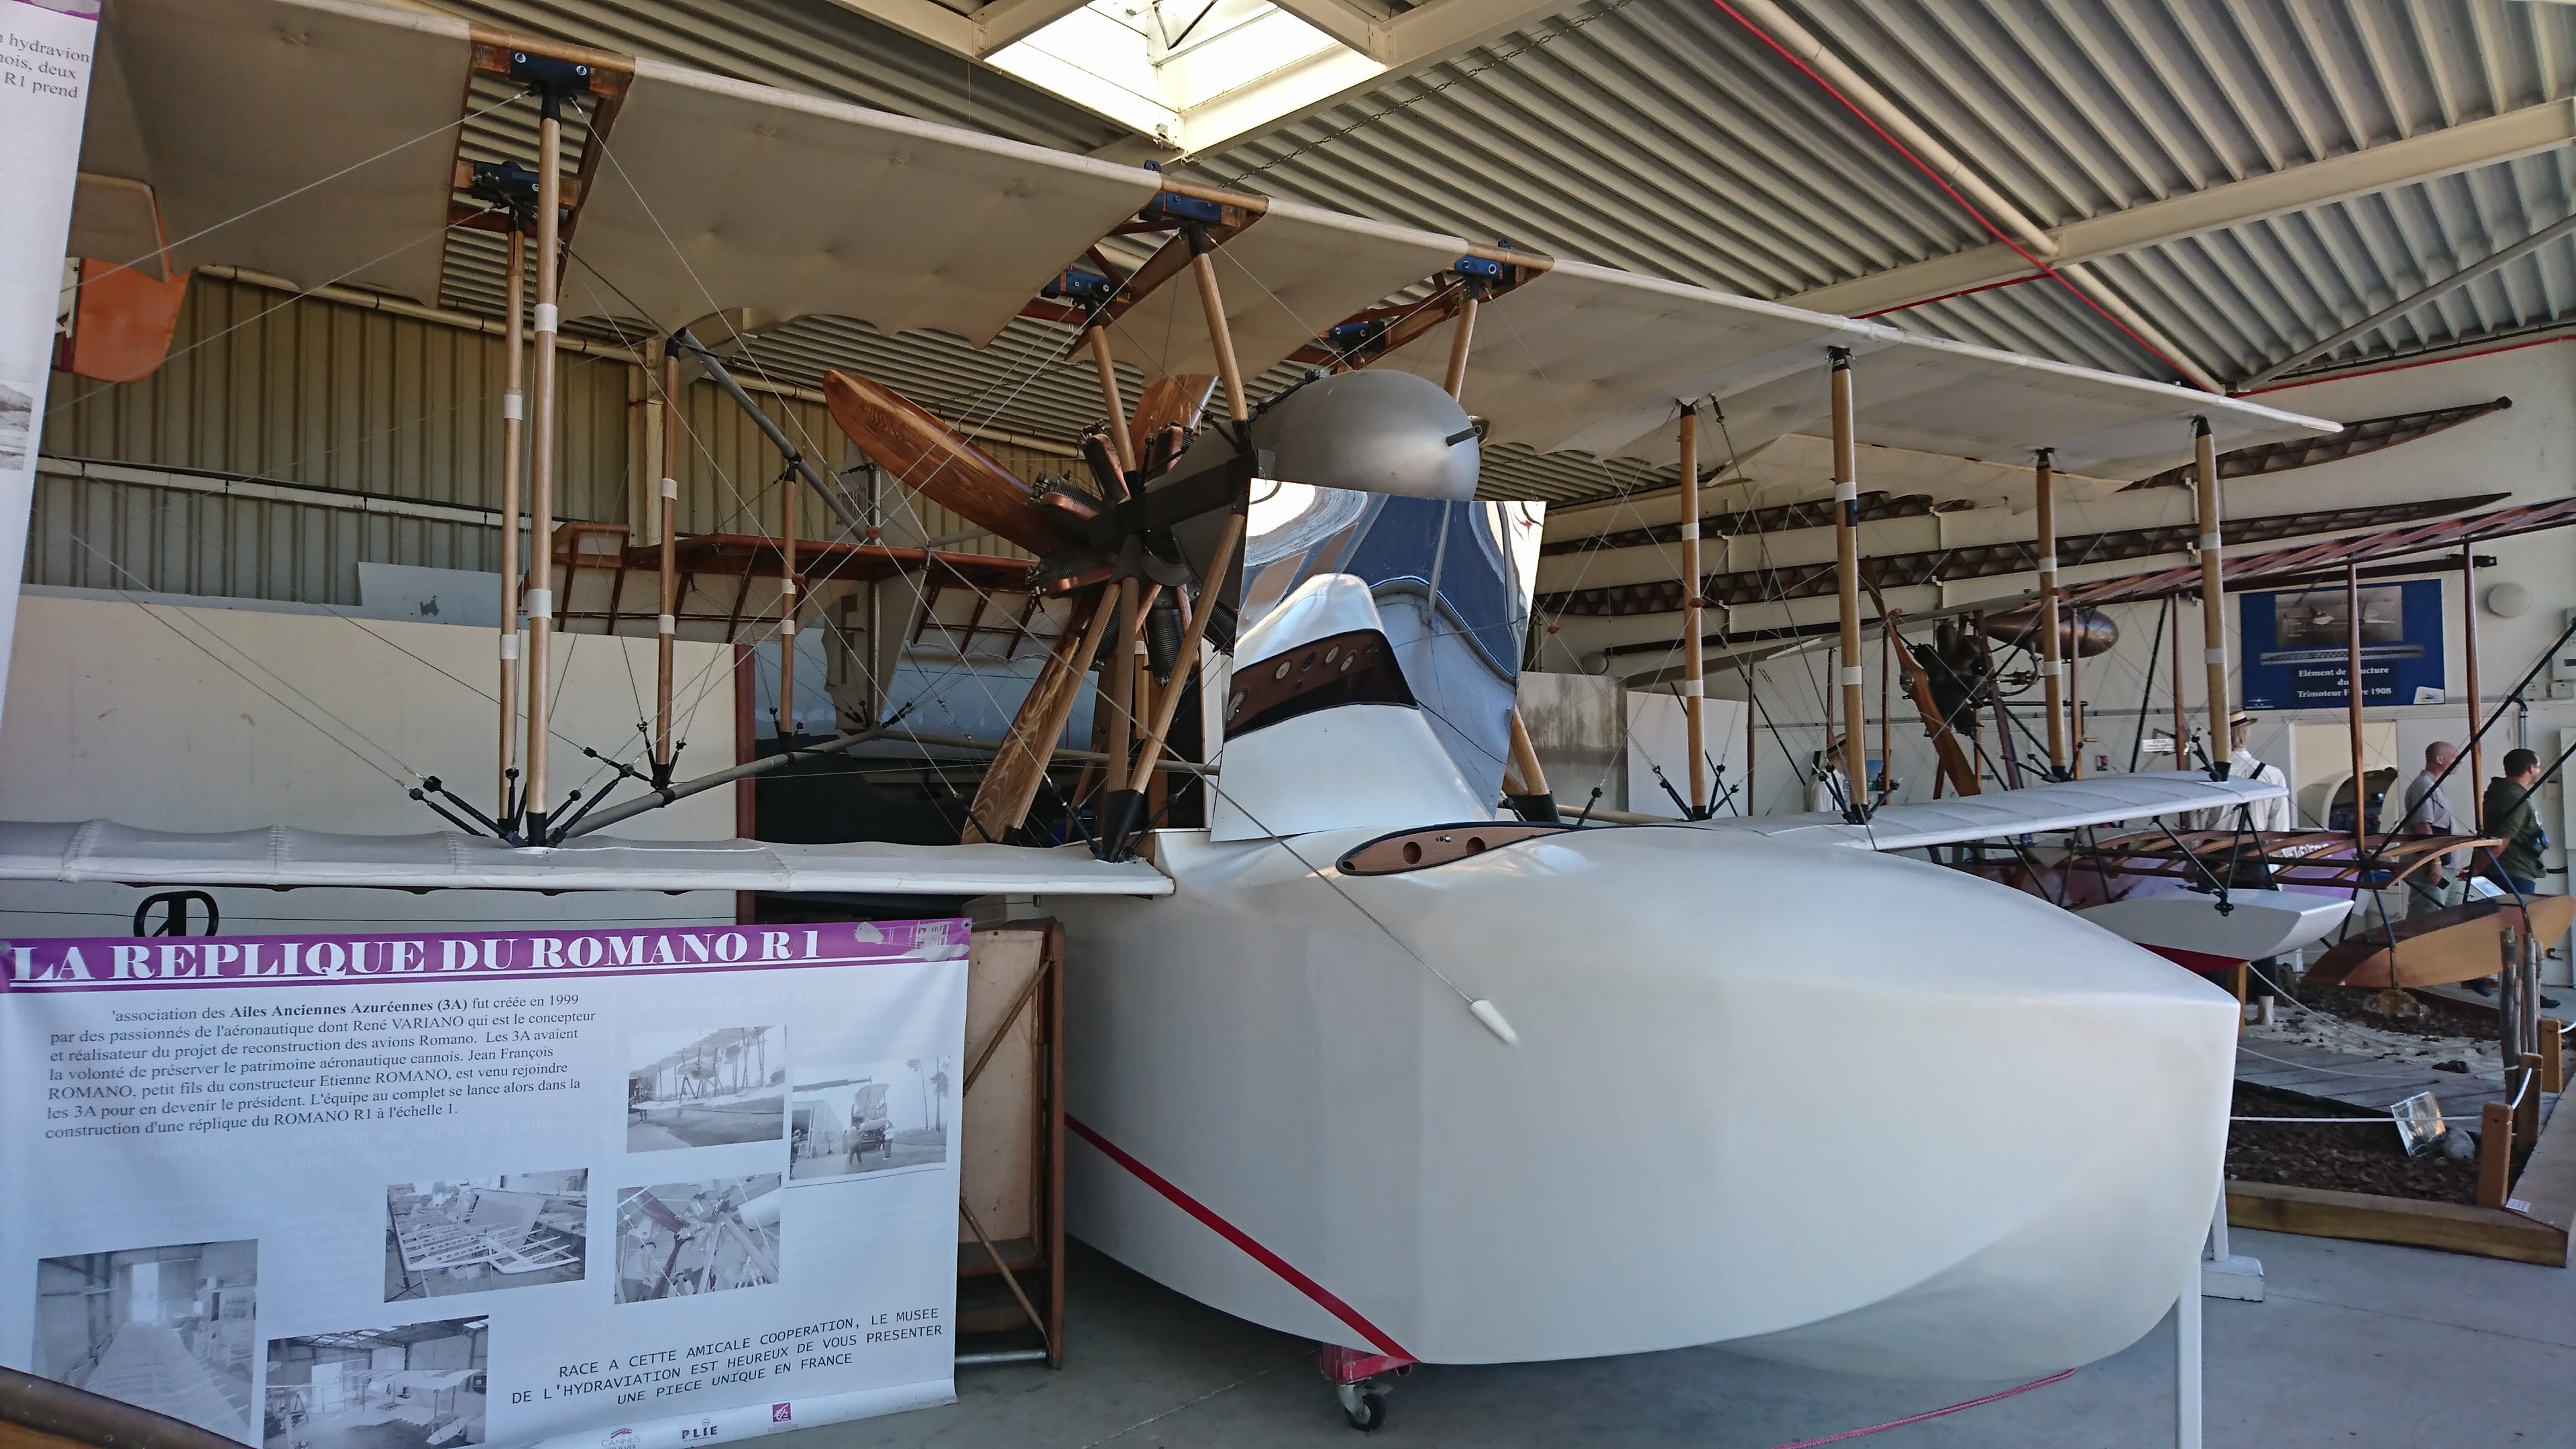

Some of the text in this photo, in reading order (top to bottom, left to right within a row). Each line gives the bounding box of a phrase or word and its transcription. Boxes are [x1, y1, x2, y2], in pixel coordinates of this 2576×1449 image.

[9, 34, 90, 63] hydravion
[4, 72, 78, 98] R1 prend
[38, 62, 76, 79] deux
[2298, 690, 2342, 698] Trimoteur
[2371, 688, 2392, 696] 1908
[10, 946, 95, 981] LA
[108, 941, 425, 980] REPLIQUE
[438, 938, 519, 971] DU
[527, 932, 749, 968] ROMANO
[201, 1007, 226, 1019] des
[229, 1006, 267, 1018] Ailes
[271, 1004, 347, 1017] Anciennes
[350, 1001, 433, 1014] Azuréennes
[437, 998, 468, 1013] (3A)
[472, 998, 490, 1009] fut
[492, 996, 527, 1008] créée
[530, 998, 545, 1007] en
[550, 994, 579, 1006] 1999
[50, 1034, 75, 1046] par
[79, 1030, 105, 1042] des
[109, 1026, 191, 1044] passionnés
[194, 1025, 212, 1038] de
[317, 1021, 349, 1033] dont
[352, 1018, 387, 1032] René
[391, 1016, 464, 1030] VARIANO
[468, 1014, 488, 1029] qui
[492, 1015, 510, 1026] est
[513, 1013, 525, 1024] le
[528, 1012, 596, 1025] concepteur
[50, 1051, 64, 1062] et
[68, 1048, 149, 1061] réalisateur
[151, 1046, 170, 1059] du
[174, 1044, 217, 1061] projet
[221, 1042, 238, 1055] de
[242, 1039, 341, 1055] reconstruction
[345, 1038, 368, 1050] des
[371, 1036, 415, 1049] avions
[486, 1032, 508, 1043] Les
[512, 1030, 531, 1042] 3A
[533, 1028, 578, 1040] avaient
[49, 1068, 63, 1081] la
[68, 1066, 124, 1080] volonté
[129, 1065, 147, 1078] de
[151, 1064, 220, 1081] préserver
[223, 1061, 237, 1073] le
[240, 1058, 316, 1076] patrimoine
[319, 1054, 407, 1069] aéronautique
[467, 1049, 496, 1061] Jean
[500, 1046, 553, 1061] François
[142, 1083, 176, 1099] petit
[180, 1081, 203, 1094] fils
[207, 1080, 225, 1093] du
[229, 1078, 317, 1091] constructeur
[319, 1074, 371, 1087] Etienne
[455, 1068, 474, 1079] est
[478, 1068, 508, 1077] venu
[512, 1062, 568, 1078] rejoindre
[47, 1107, 68, 1120] les
[74, 1105, 97, 1118] 3A
[101, 1107, 136, 1120] pour
[139, 1106, 156, 1116] en
[161, 1099, 217, 1114] devenir
[221, 1098, 234, 1110] le
[372, 1093, 388, 1102] au
[392, 1086, 445, 1102] complet
[449, 1088, 463, 1097] se
[467, 1084, 500, 1095] lance
[503, 1081, 535, 1093] alors
[537, 1079, 566, 1091] dans
[570, 1078, 581, 1089] la
[45, 1122, 140, 1139] construction
[188, 1117, 248, 1134] réplique
[251, 1114, 269, 1127] du
[273, 1110, 350, 1126] ROMANO
[354, 1108, 371, 1121] R1
[376, 1108, 384, 1119] à
[559, 1307, 938, 1379] RACE A CETTE AMICALE COOPERATION, LE MUSEE
[512, 1325, 943, 1405] DE L'HYDRAVIATION EST HEUREUX DE VOUS PRESENTER
[617, 1352, 853, 1405] UNE PIECE UNIQUE EN FRANCE
[601, 1435, 641, 1447] CANNES
[682, 1426, 718, 1440] PLIE
